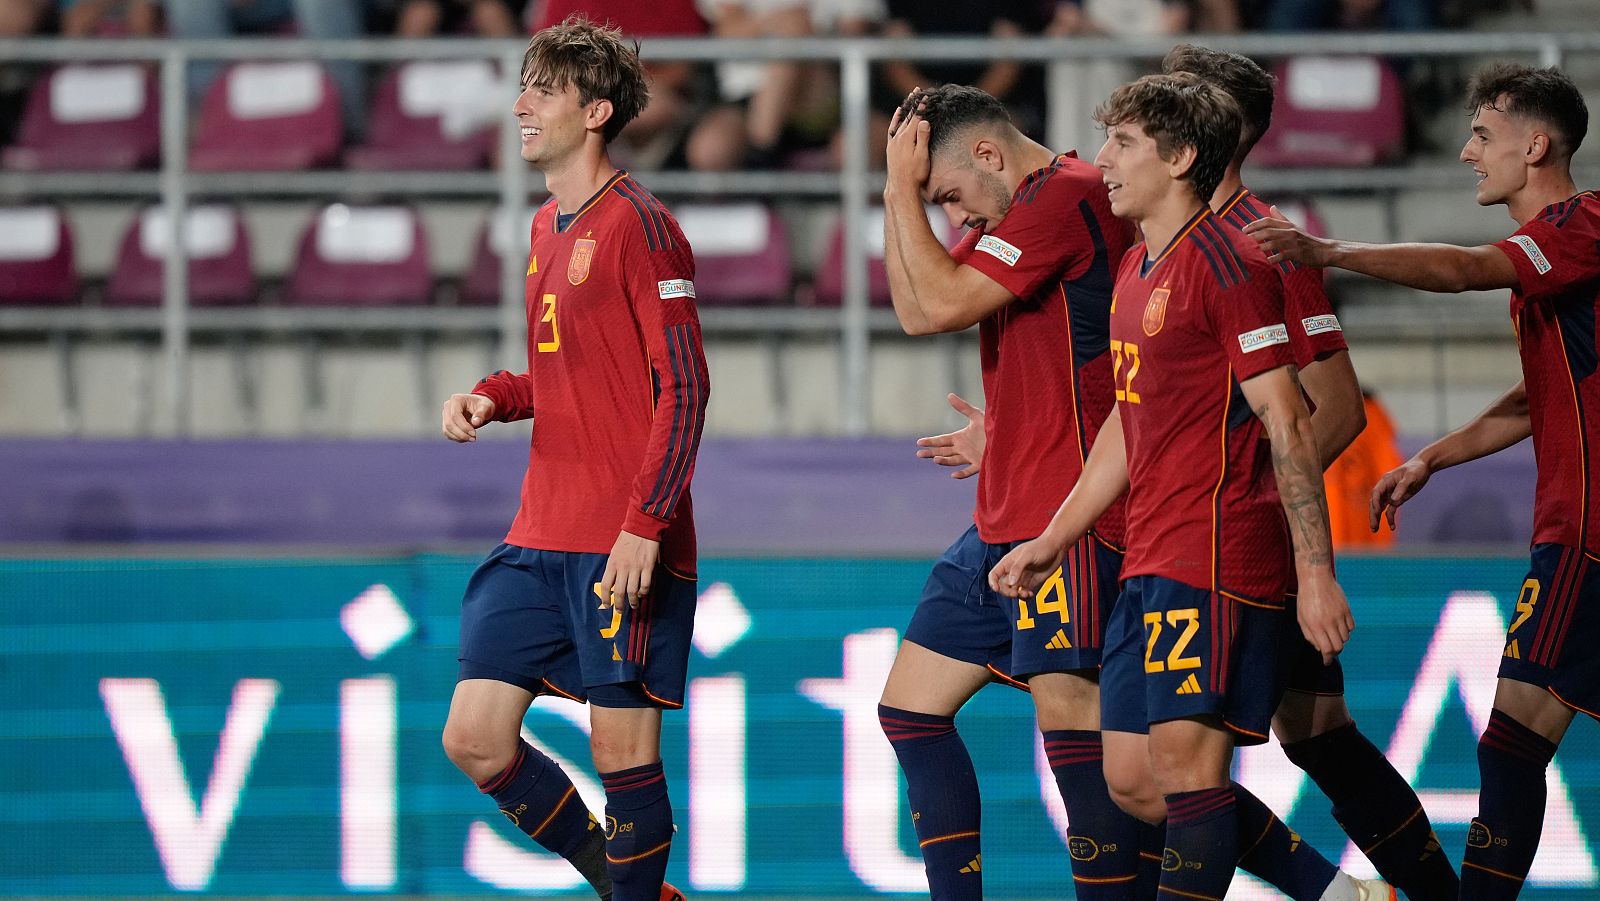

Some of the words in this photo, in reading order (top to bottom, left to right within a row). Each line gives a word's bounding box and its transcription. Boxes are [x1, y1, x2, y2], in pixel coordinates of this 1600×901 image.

[537, 294, 560, 353] 3
[1508, 578, 1540, 633] 9
[1143, 608, 1202, 673] 22
